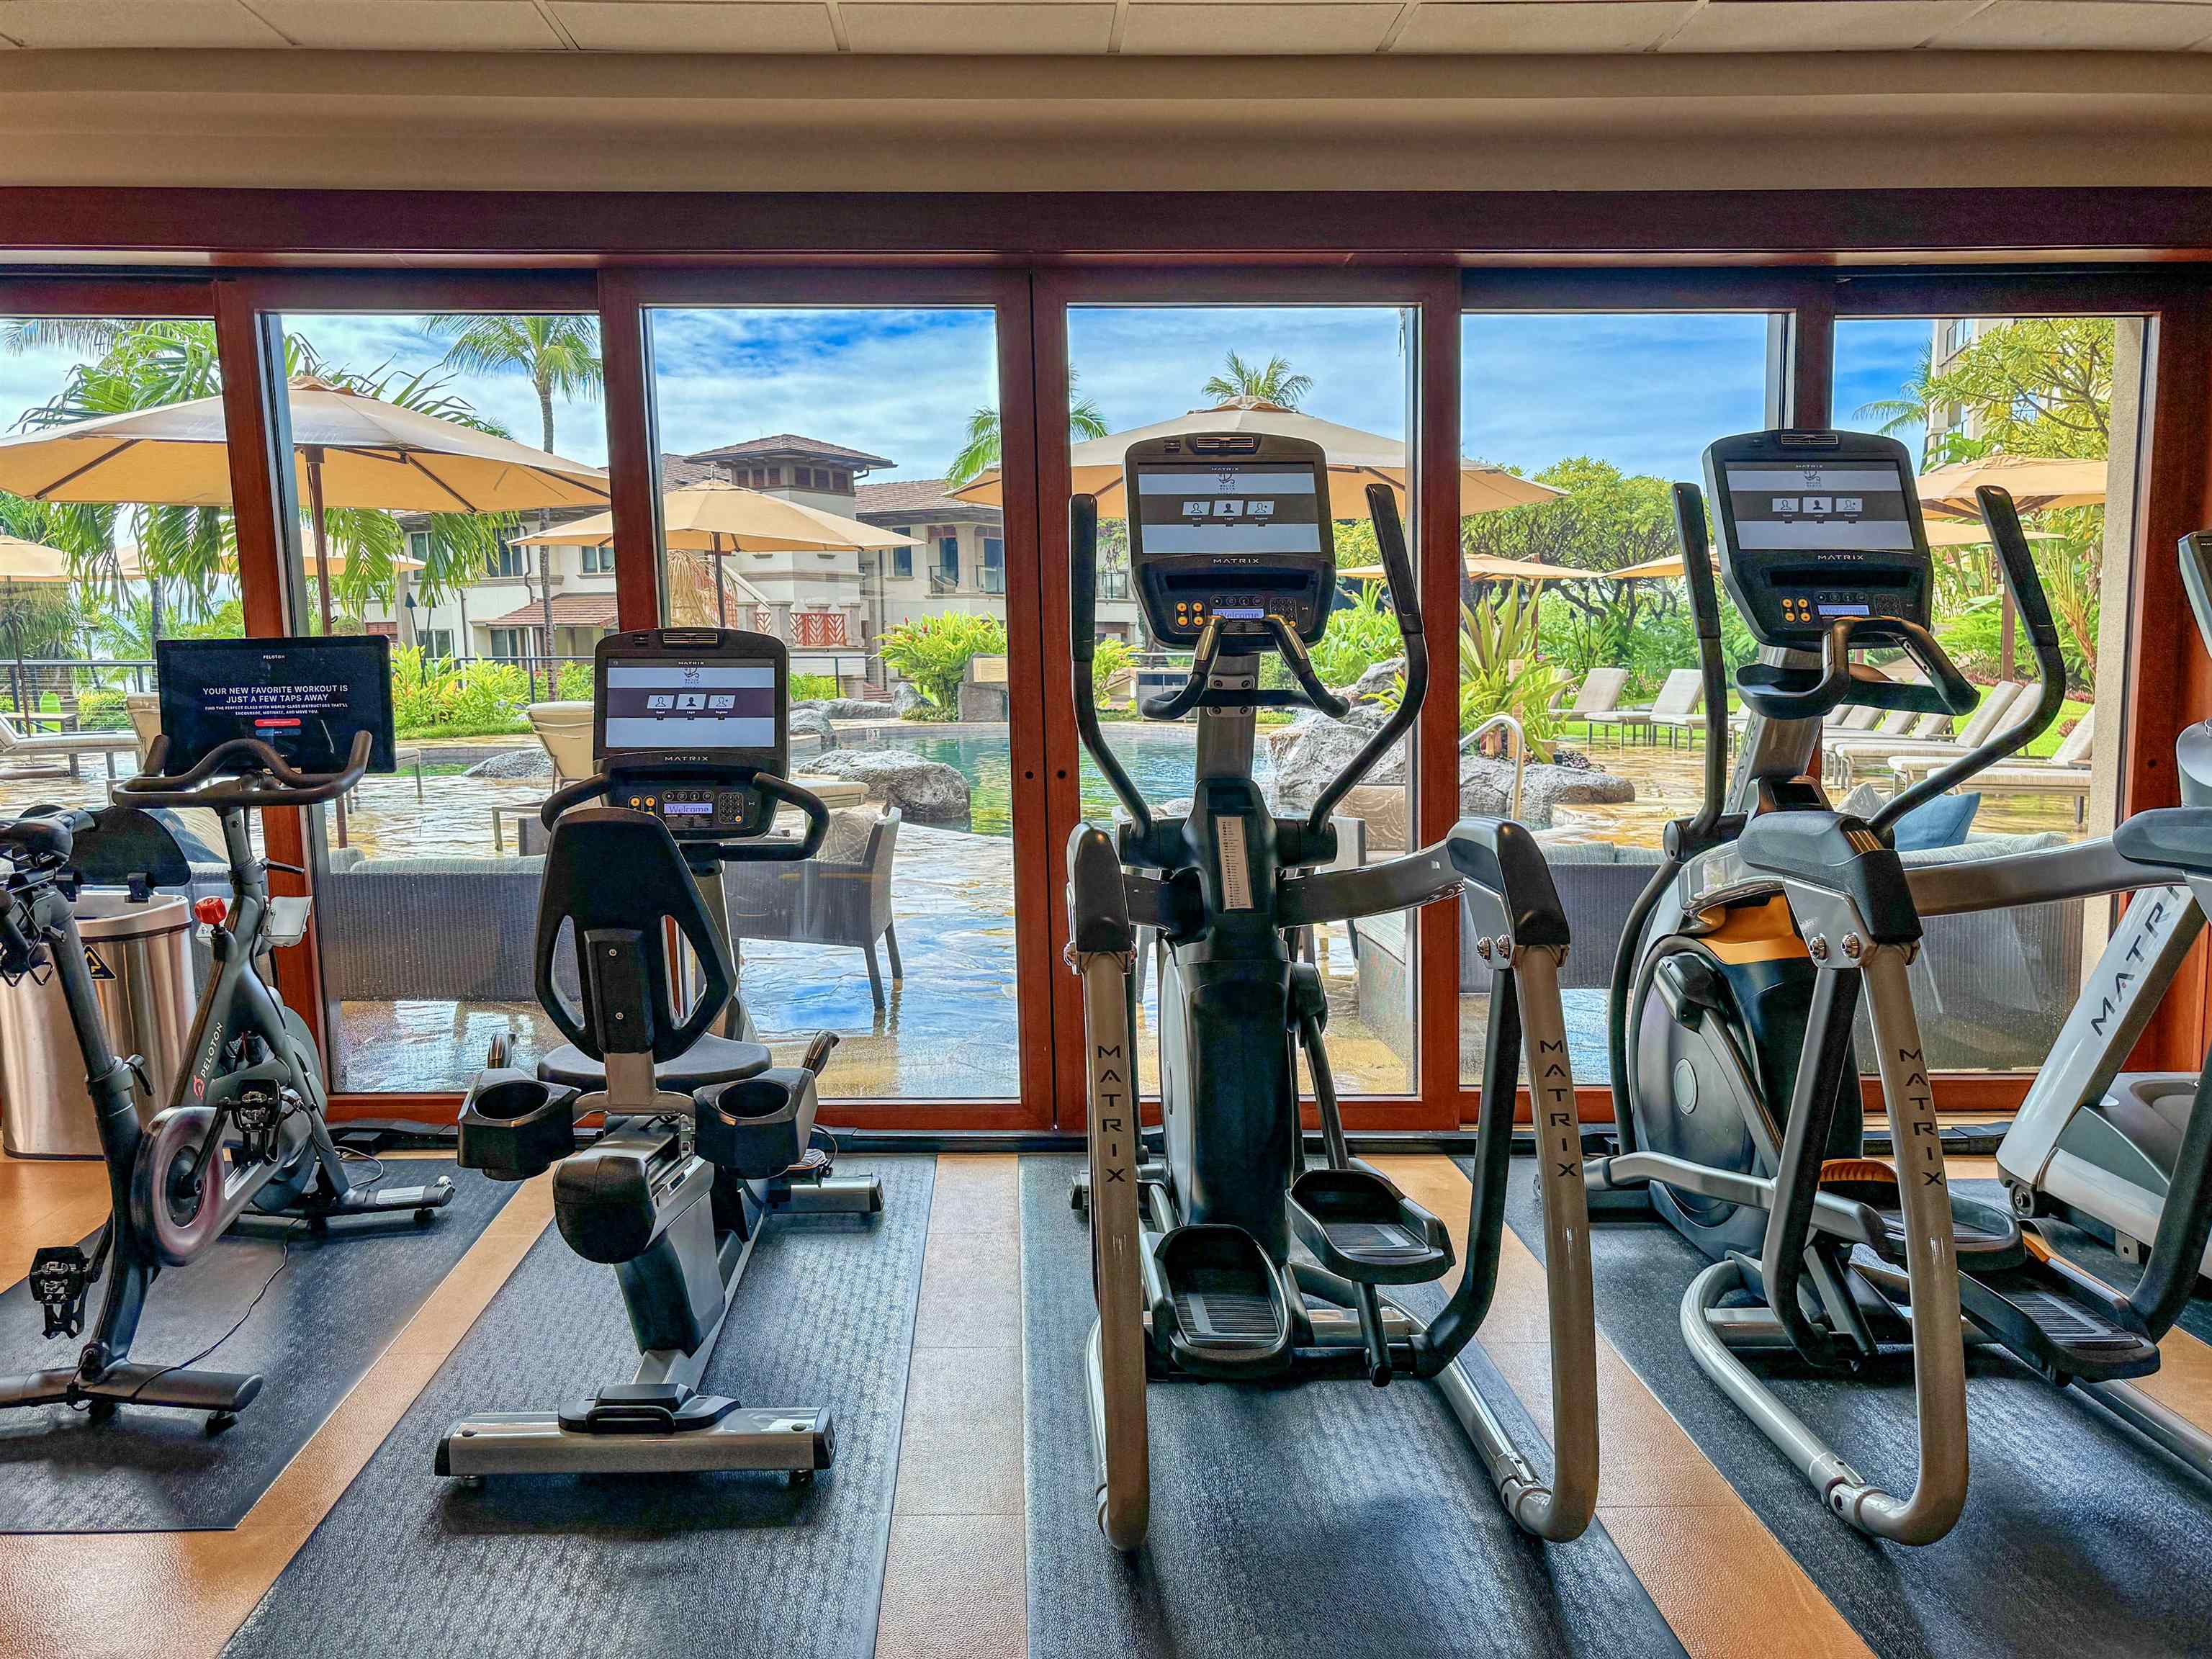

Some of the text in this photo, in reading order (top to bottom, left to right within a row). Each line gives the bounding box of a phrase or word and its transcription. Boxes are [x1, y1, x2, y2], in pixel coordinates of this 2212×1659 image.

[251, 685, 292, 694] FAVORITE
[668, 805, 709, 814] Welcome
[2090, 886, 2180, 1037] MATRI
[201, 1022, 223, 1078] PELOTON
[1097, 1045, 1126, 1183] MATRIX
[1539, 1040, 1578, 1177] MATRIX
[1899, 1048, 1943, 1186] MATRIX
